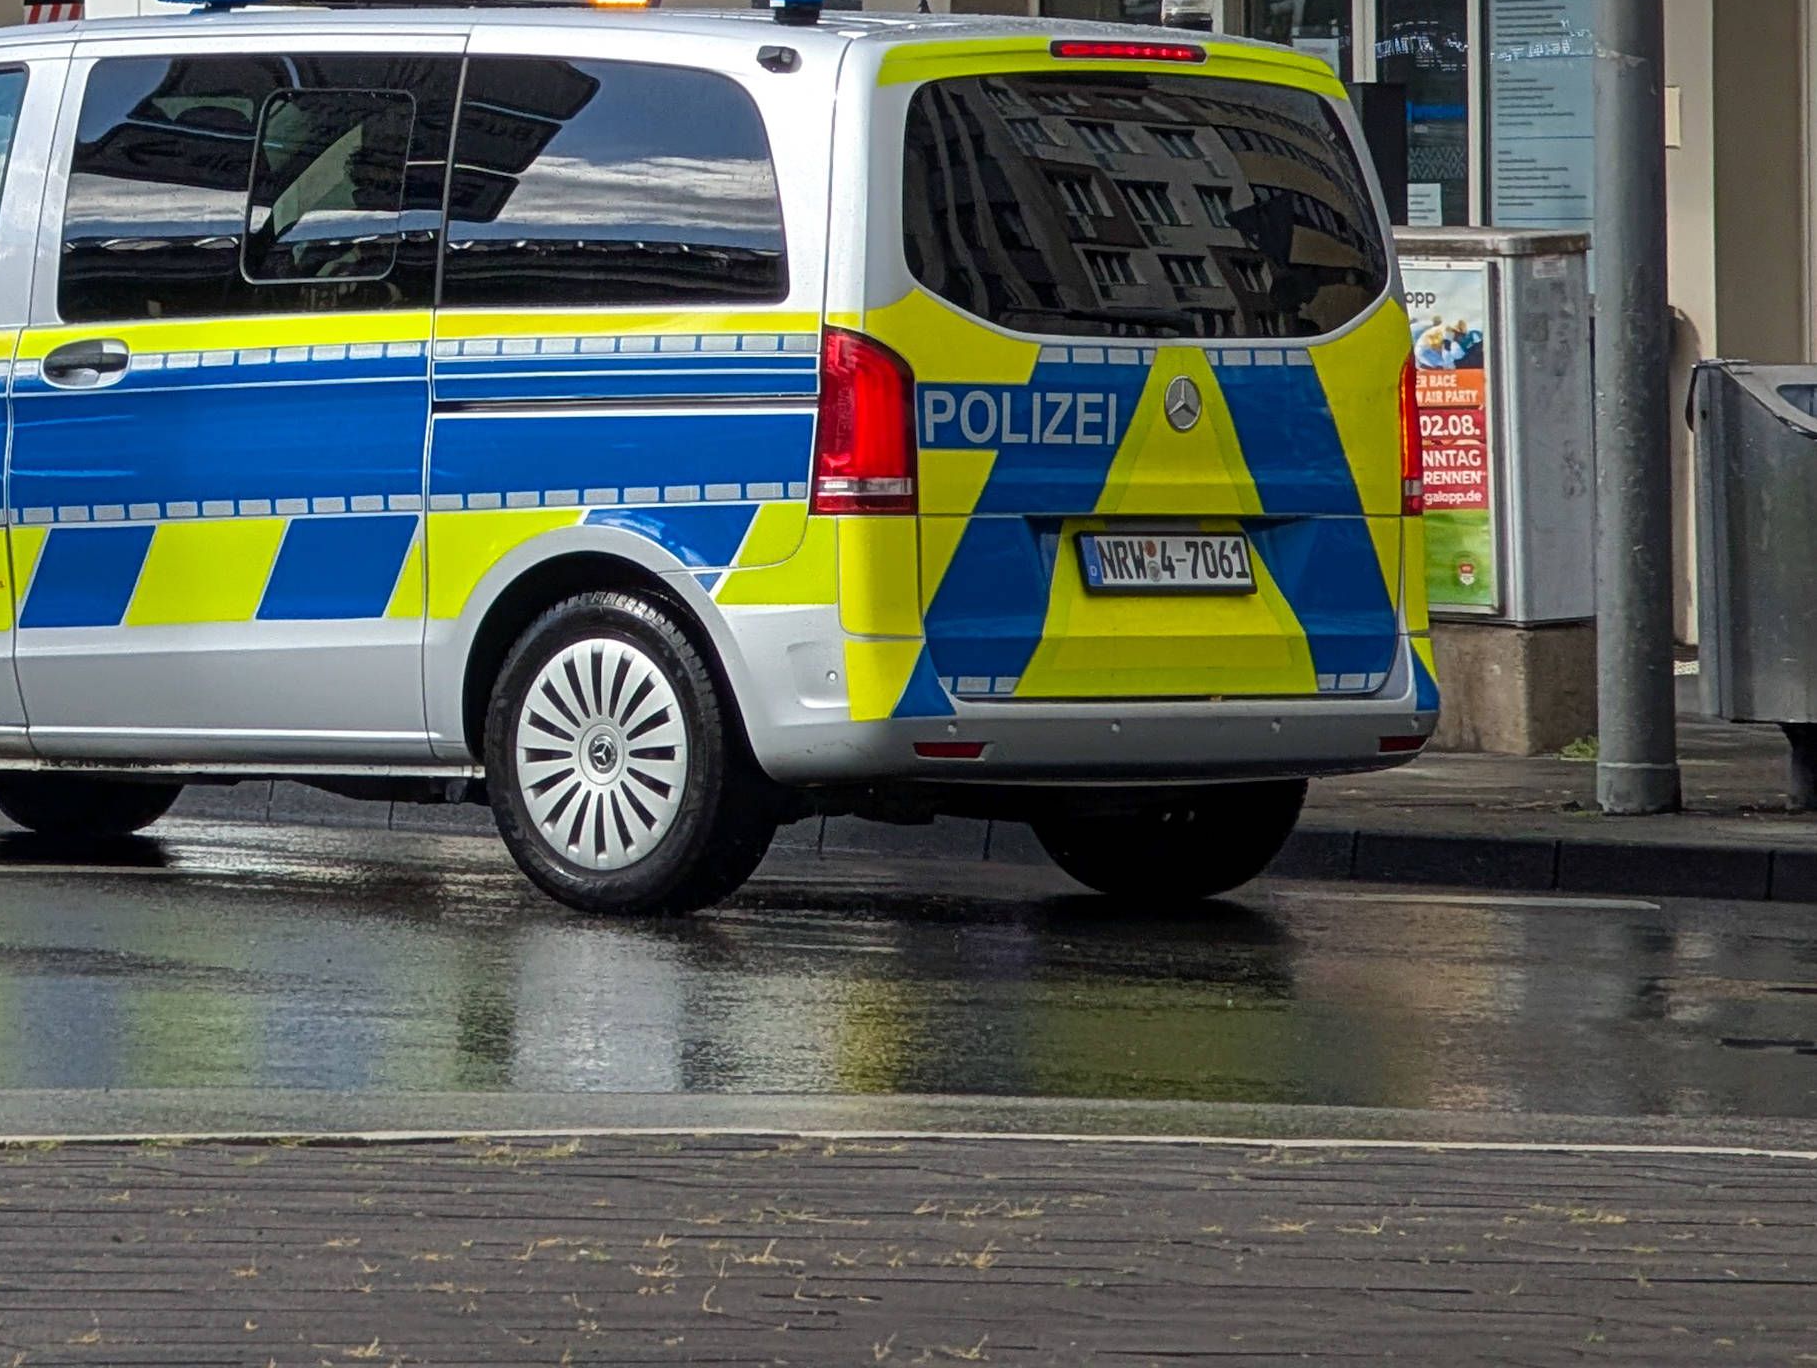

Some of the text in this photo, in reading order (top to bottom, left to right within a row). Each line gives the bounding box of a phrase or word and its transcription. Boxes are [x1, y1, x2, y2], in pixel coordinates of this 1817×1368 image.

[1430, 374, 1458, 388] RACE
[1425, 390, 1443, 403] AIR
[1445, 389, 1479, 403] PARTY
[924, 390, 1117, 446] POLIZEI
[1420, 415, 1481, 436] 02.08.
[1097, 540, 1147, 579] NRW
[1161, 540, 1250, 579] 4-7061
